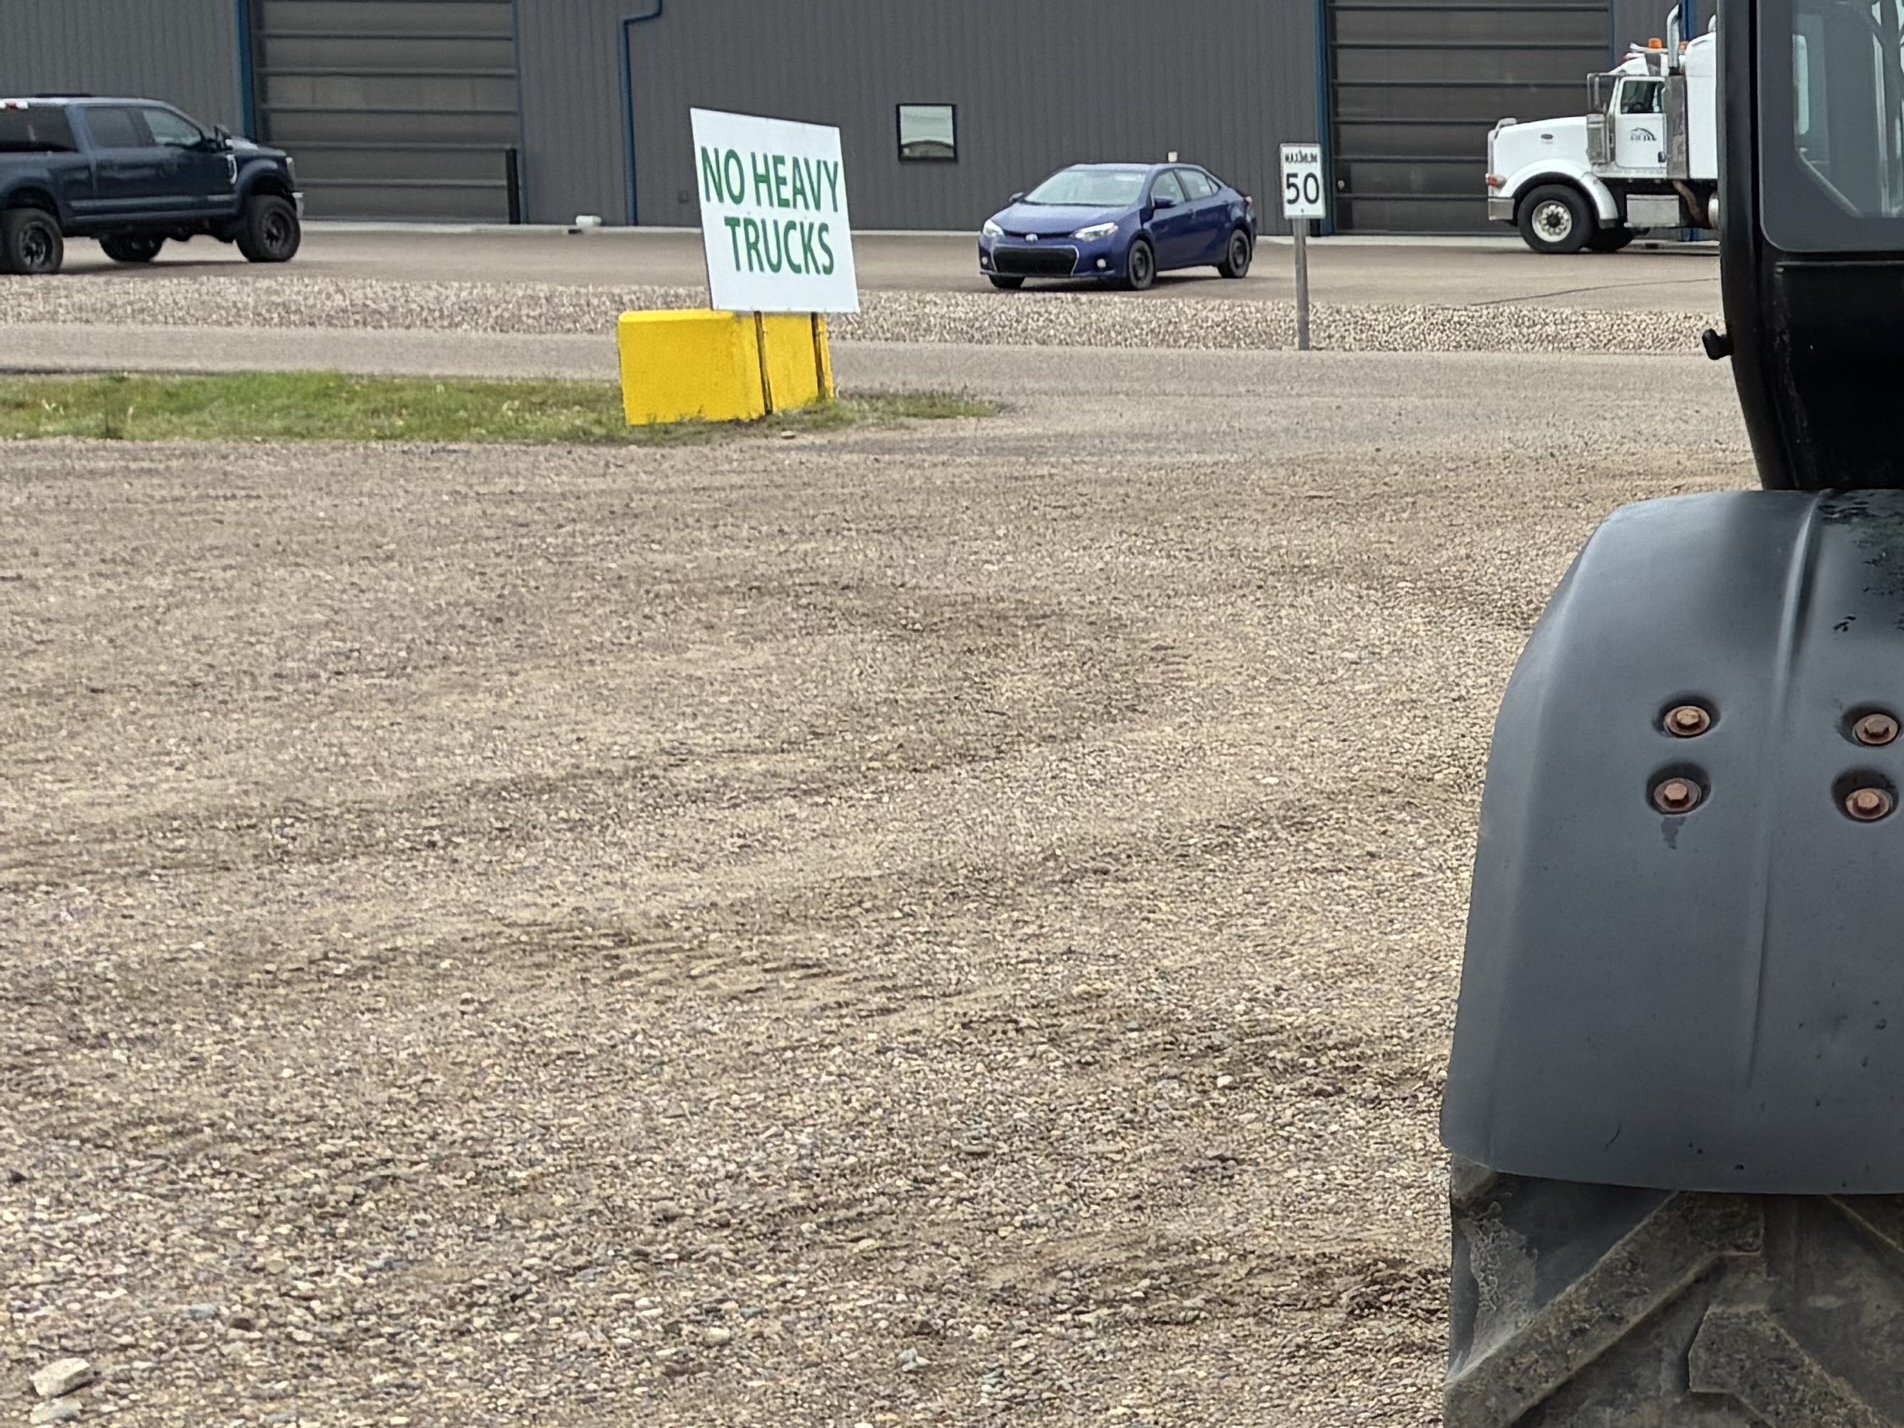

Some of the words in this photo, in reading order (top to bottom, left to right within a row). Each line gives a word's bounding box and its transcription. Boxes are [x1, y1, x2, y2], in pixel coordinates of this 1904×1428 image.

[701, 145, 745, 205] NO
[751, 151, 839, 213] HEAVY
[1286, 172, 1320, 205] 50
[724, 215, 834, 276] TRUCKS
